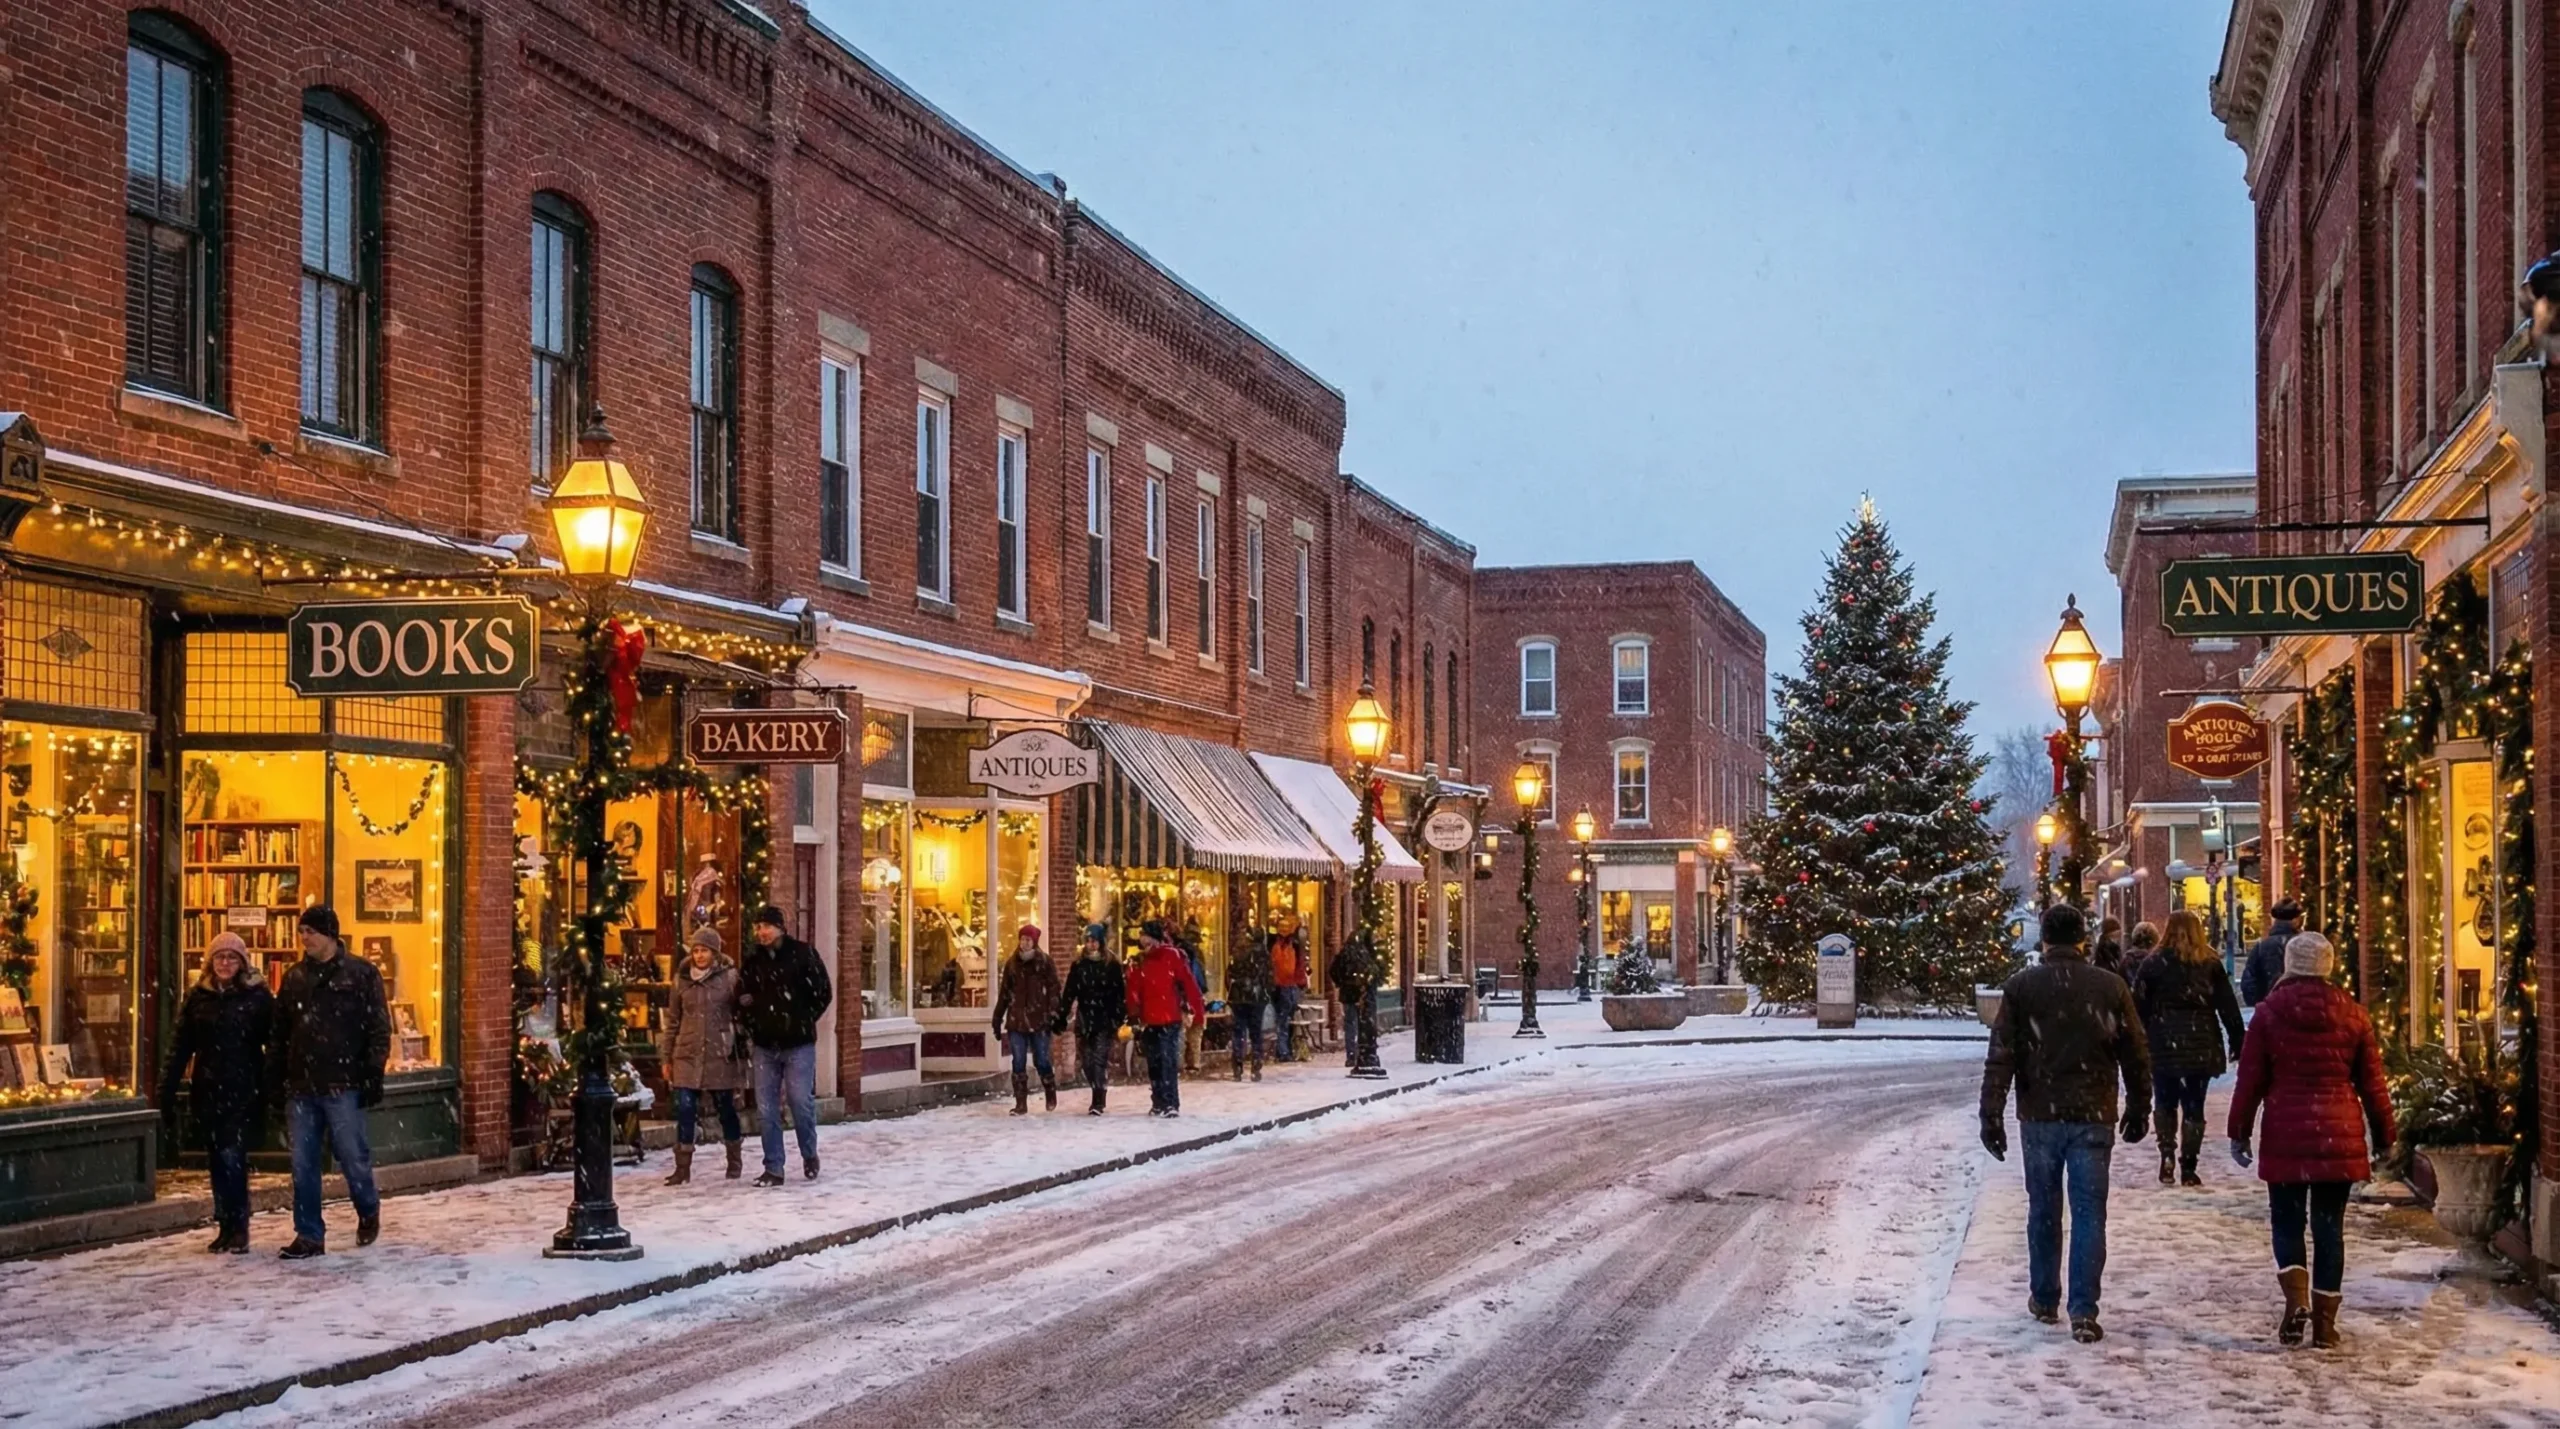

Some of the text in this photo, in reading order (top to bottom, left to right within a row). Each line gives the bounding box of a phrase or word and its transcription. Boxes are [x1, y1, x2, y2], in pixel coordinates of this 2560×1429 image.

[2174, 571, 2409, 621] ANTIQUES
[306, 617, 515, 678] BOOKS
[701, 721, 832, 752] BAKERY
[978, 757, 1088, 780] ANTIQUES
